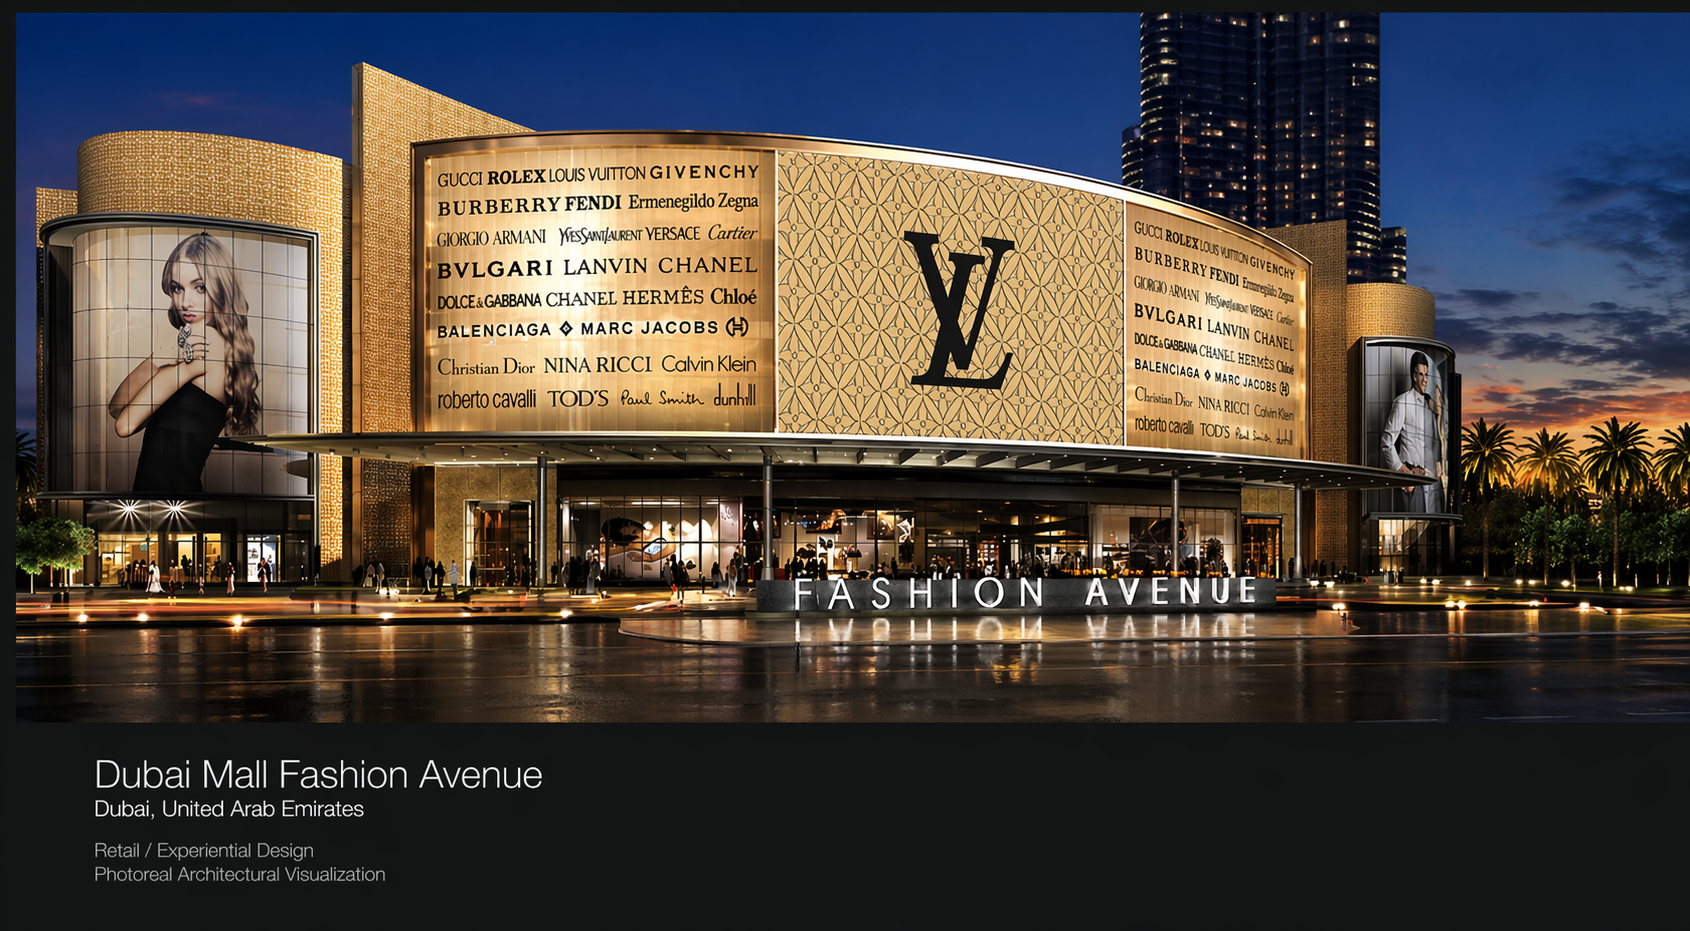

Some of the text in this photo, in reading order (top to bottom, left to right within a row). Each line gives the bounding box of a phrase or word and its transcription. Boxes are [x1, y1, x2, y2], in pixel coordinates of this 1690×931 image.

[437, 165, 759, 188] GUCCI ROLEX LOUIS VUITTON GIVENCHY
[438, 192, 759, 217] BURBERRY FENDI Ermenegildo Zegna
[437, 231, 489, 248] GIORGIO
[492, 229, 546, 246] ARMANI
[645, 226, 700, 241] VERSACE
[708, 223, 758, 240] Cartier
[1134, 221, 1163, 240] GUCCI
[1165, 229, 1200, 250] ROLEX
[1200, 240, 1219, 256] LOUIS
[1250, 256, 1295, 280] GIVENCHY
[437, 256, 758, 279] BVLGARI LANVIN CHANEL
[1134, 246, 1207, 277] BURBERRY
[1210, 266, 1239, 287] FENDI
[545, 291, 617, 307] CHANEL
[622, 285, 704, 305] HERMÊS
[710, 287, 758, 305] Chloé
[1134, 275, 1167, 295] GIORGIO
[1169, 284, 1199, 302] ARMANI
[437, 323, 551, 339] BALENCIAGA
[581, 321, 633, 336] MARC
[641, 320, 718, 335] JACOBS
[1134, 302, 1294, 351] BVLGARI LANVIN CHANEL
[437, 354, 757, 376] Christian Dior NINA RICCI Calvin Klein
[1199, 344, 1235, 363] CHANEL
[1134, 358, 1200, 379] BALENCIAGA
[1215, 372, 1240, 387] MARC
[1243, 377, 1276, 392] JACOBS
[438, 382, 756, 410] roberto cavalli TOD'S Paul Smith dunhill
[1135, 385, 1172, 405] Christian
[1175, 391, 1193, 408] Dior
[1198, 395, 1221, 411] NINA
[1224, 399, 1250, 416] RICCI
[1135, 415, 1167, 433] roberto
[1200, 422, 1230, 439] TOD'S
[795, 576, 1256, 610] FASHION AVENUE
